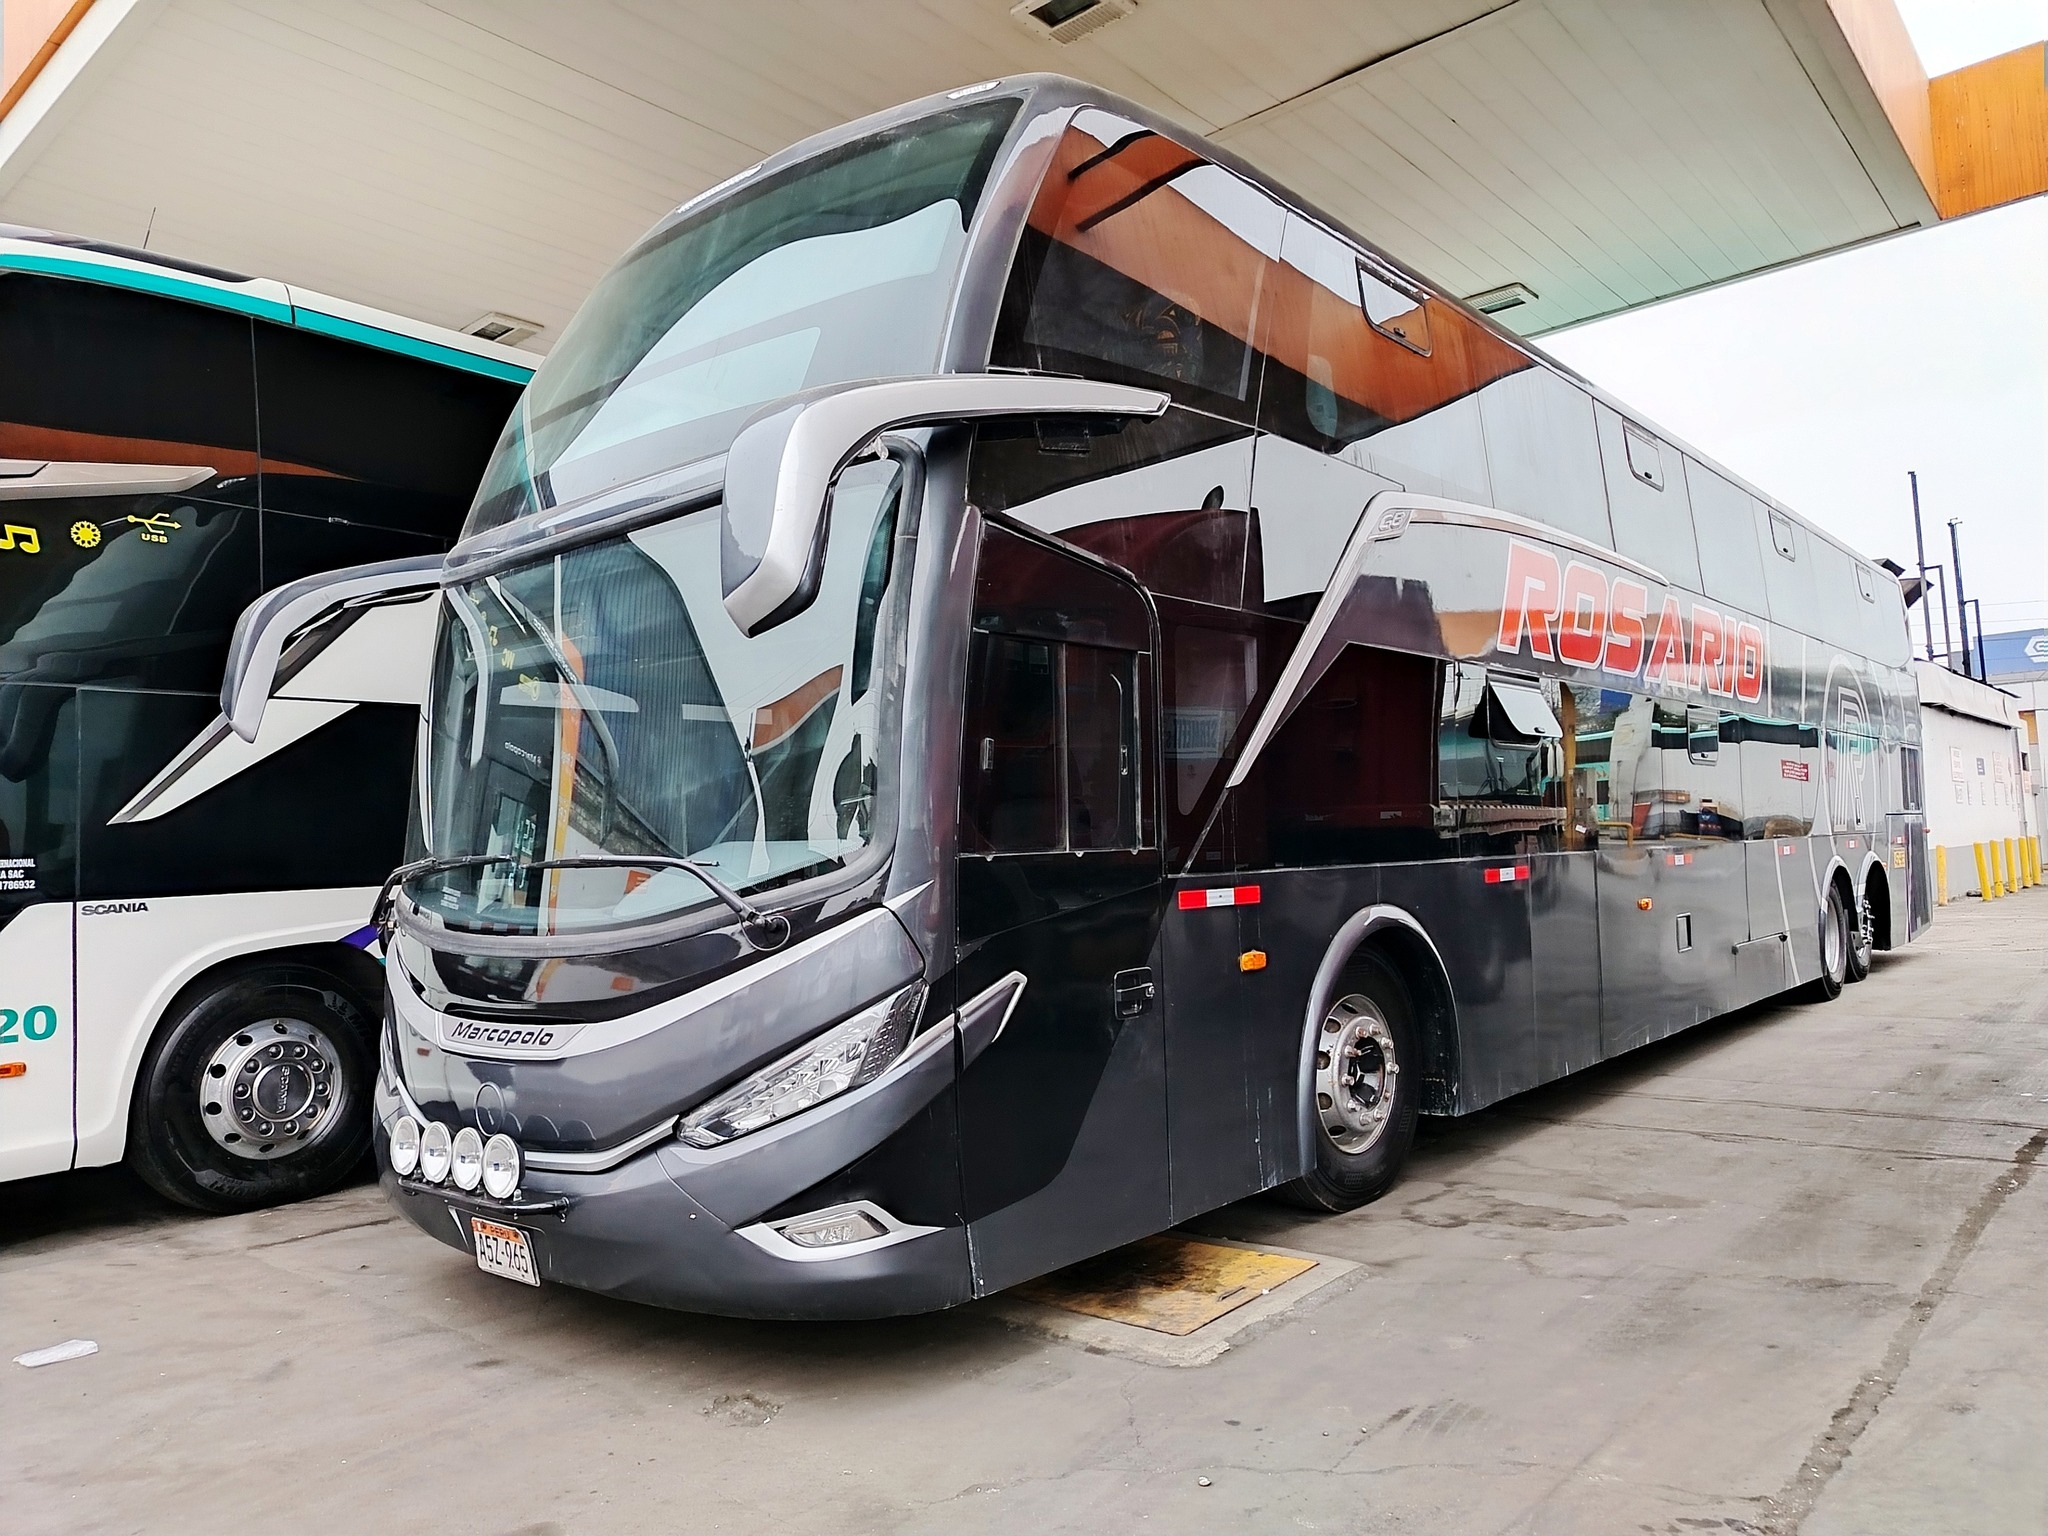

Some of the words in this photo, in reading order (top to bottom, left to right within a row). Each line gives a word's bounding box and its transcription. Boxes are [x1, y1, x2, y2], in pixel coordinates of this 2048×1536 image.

[141, 533, 168, 544] USB
[1497, 537, 1764, 704] ROSARIO
[8, 869, 25, 879] SAC
[81, 902, 149, 916] SCANIA
[450, 1021, 554, 1046] Marcopolo
[275, 1065, 290, 1114] SCANIA
[478, 1233, 529, 1274] A5Z-965
